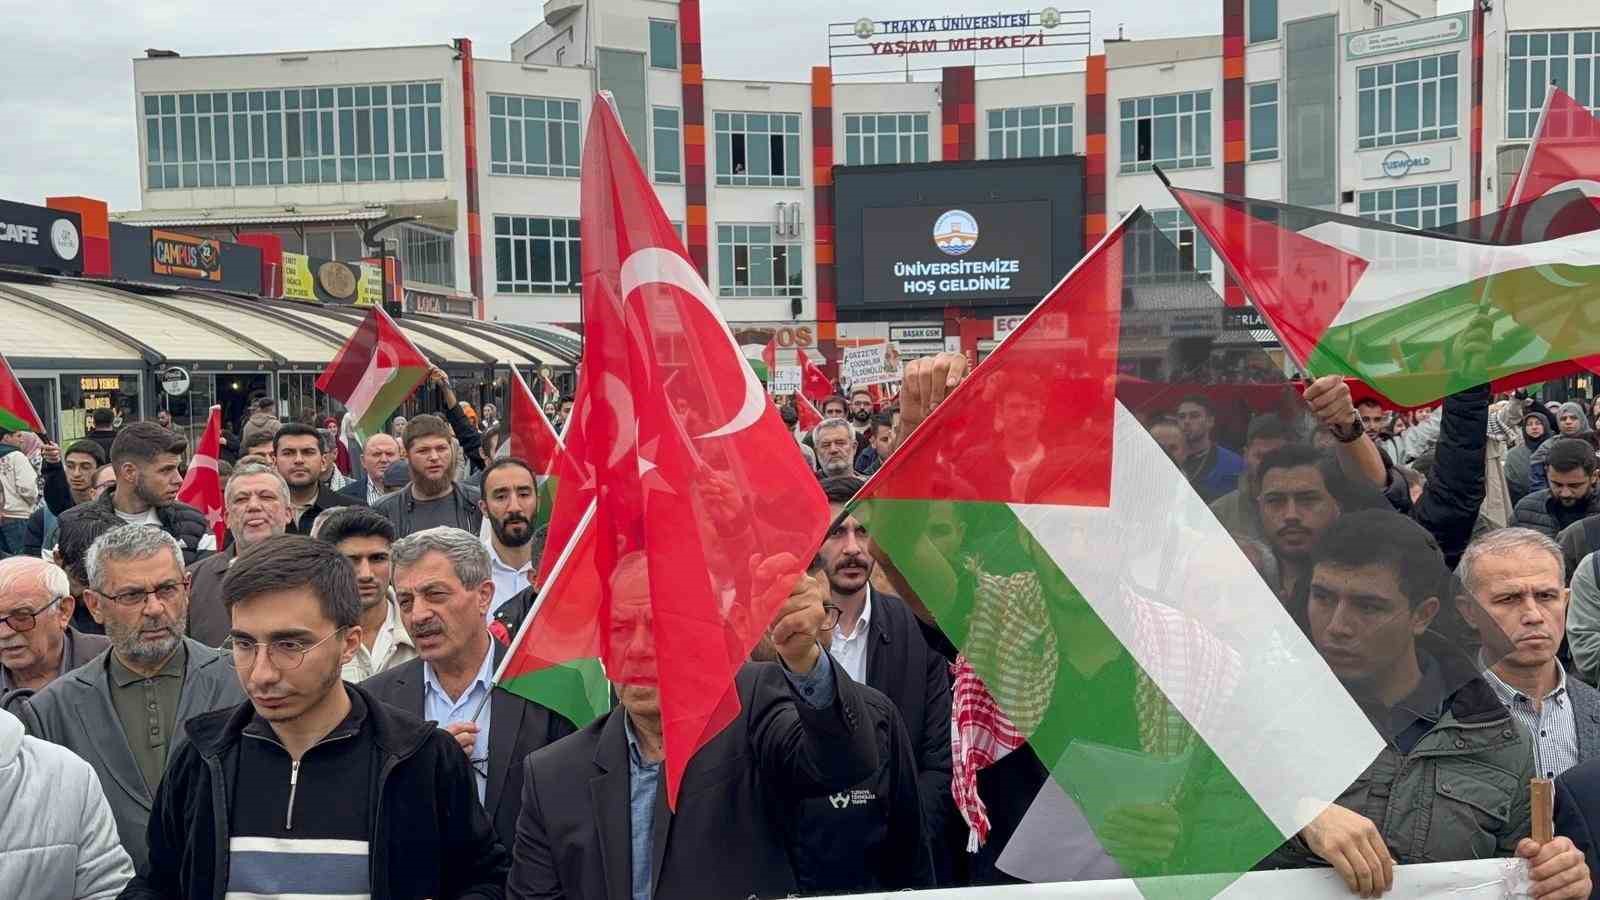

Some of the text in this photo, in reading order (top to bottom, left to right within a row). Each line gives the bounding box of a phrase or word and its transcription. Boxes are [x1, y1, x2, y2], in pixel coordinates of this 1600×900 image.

[882, 10, 1031, 33] TRAKYA ÜNİVERSİTESİ
[870, 30, 1044, 57] YAŞAM MERKEZİ
[156, 241, 198, 266] CAMPUS
[894, 257, 1020, 276] ÜNİVERSİTEMİZE
[903, 275, 1011, 295] HOŞ GELDİNİZ
